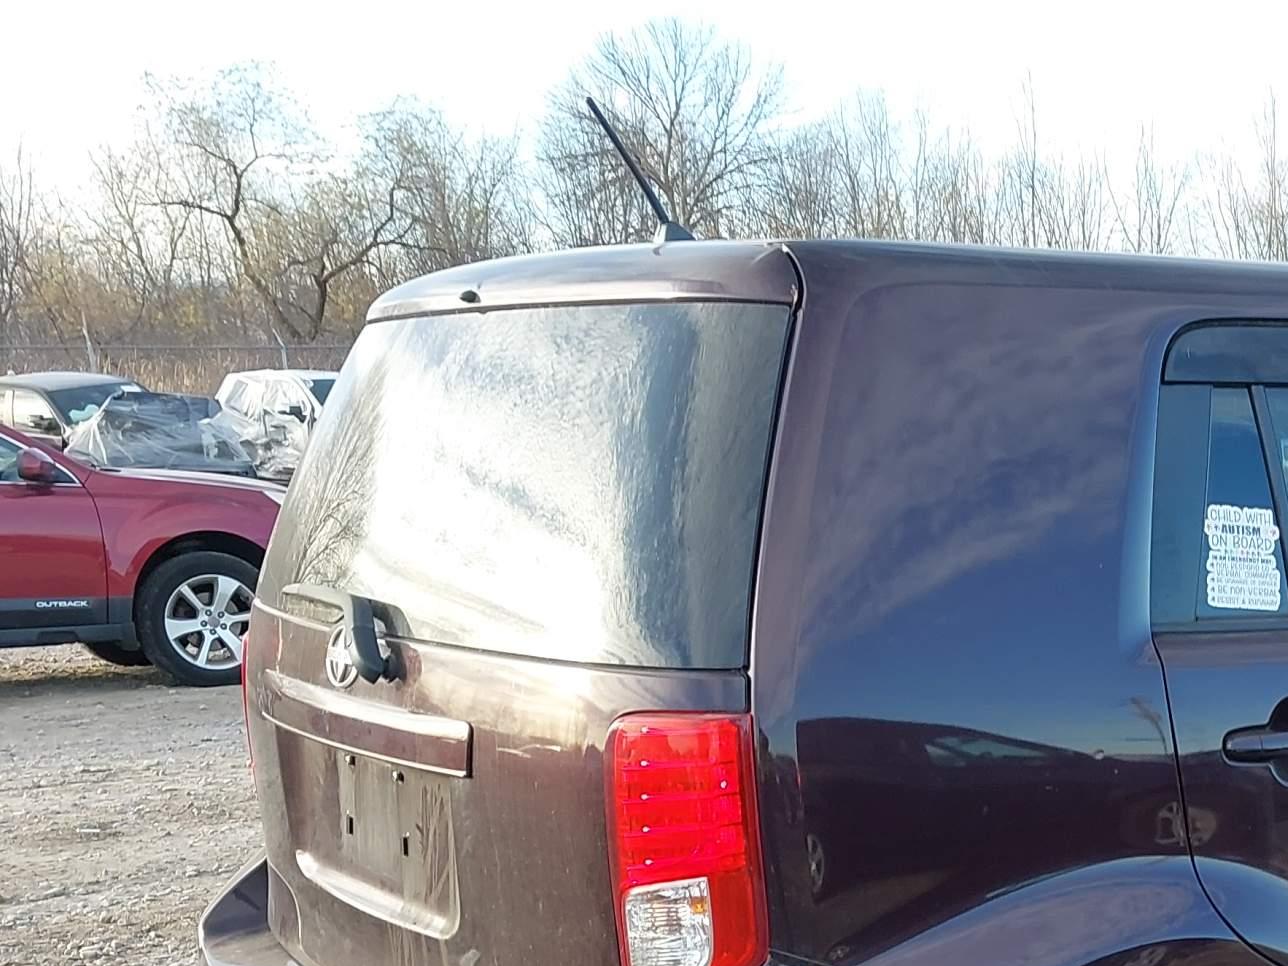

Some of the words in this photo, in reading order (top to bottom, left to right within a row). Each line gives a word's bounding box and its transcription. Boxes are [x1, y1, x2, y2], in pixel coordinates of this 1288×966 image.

[1210, 509, 1241, 522] CHILD
[1245, 511, 1271, 526] WITH
[1221, 524, 1261, 536] AUTISM
[1211, 535, 1227, 546] ON
[1232, 536, 1272, 551] BOARD
[36, 600, 88, 608] OUTBACK
